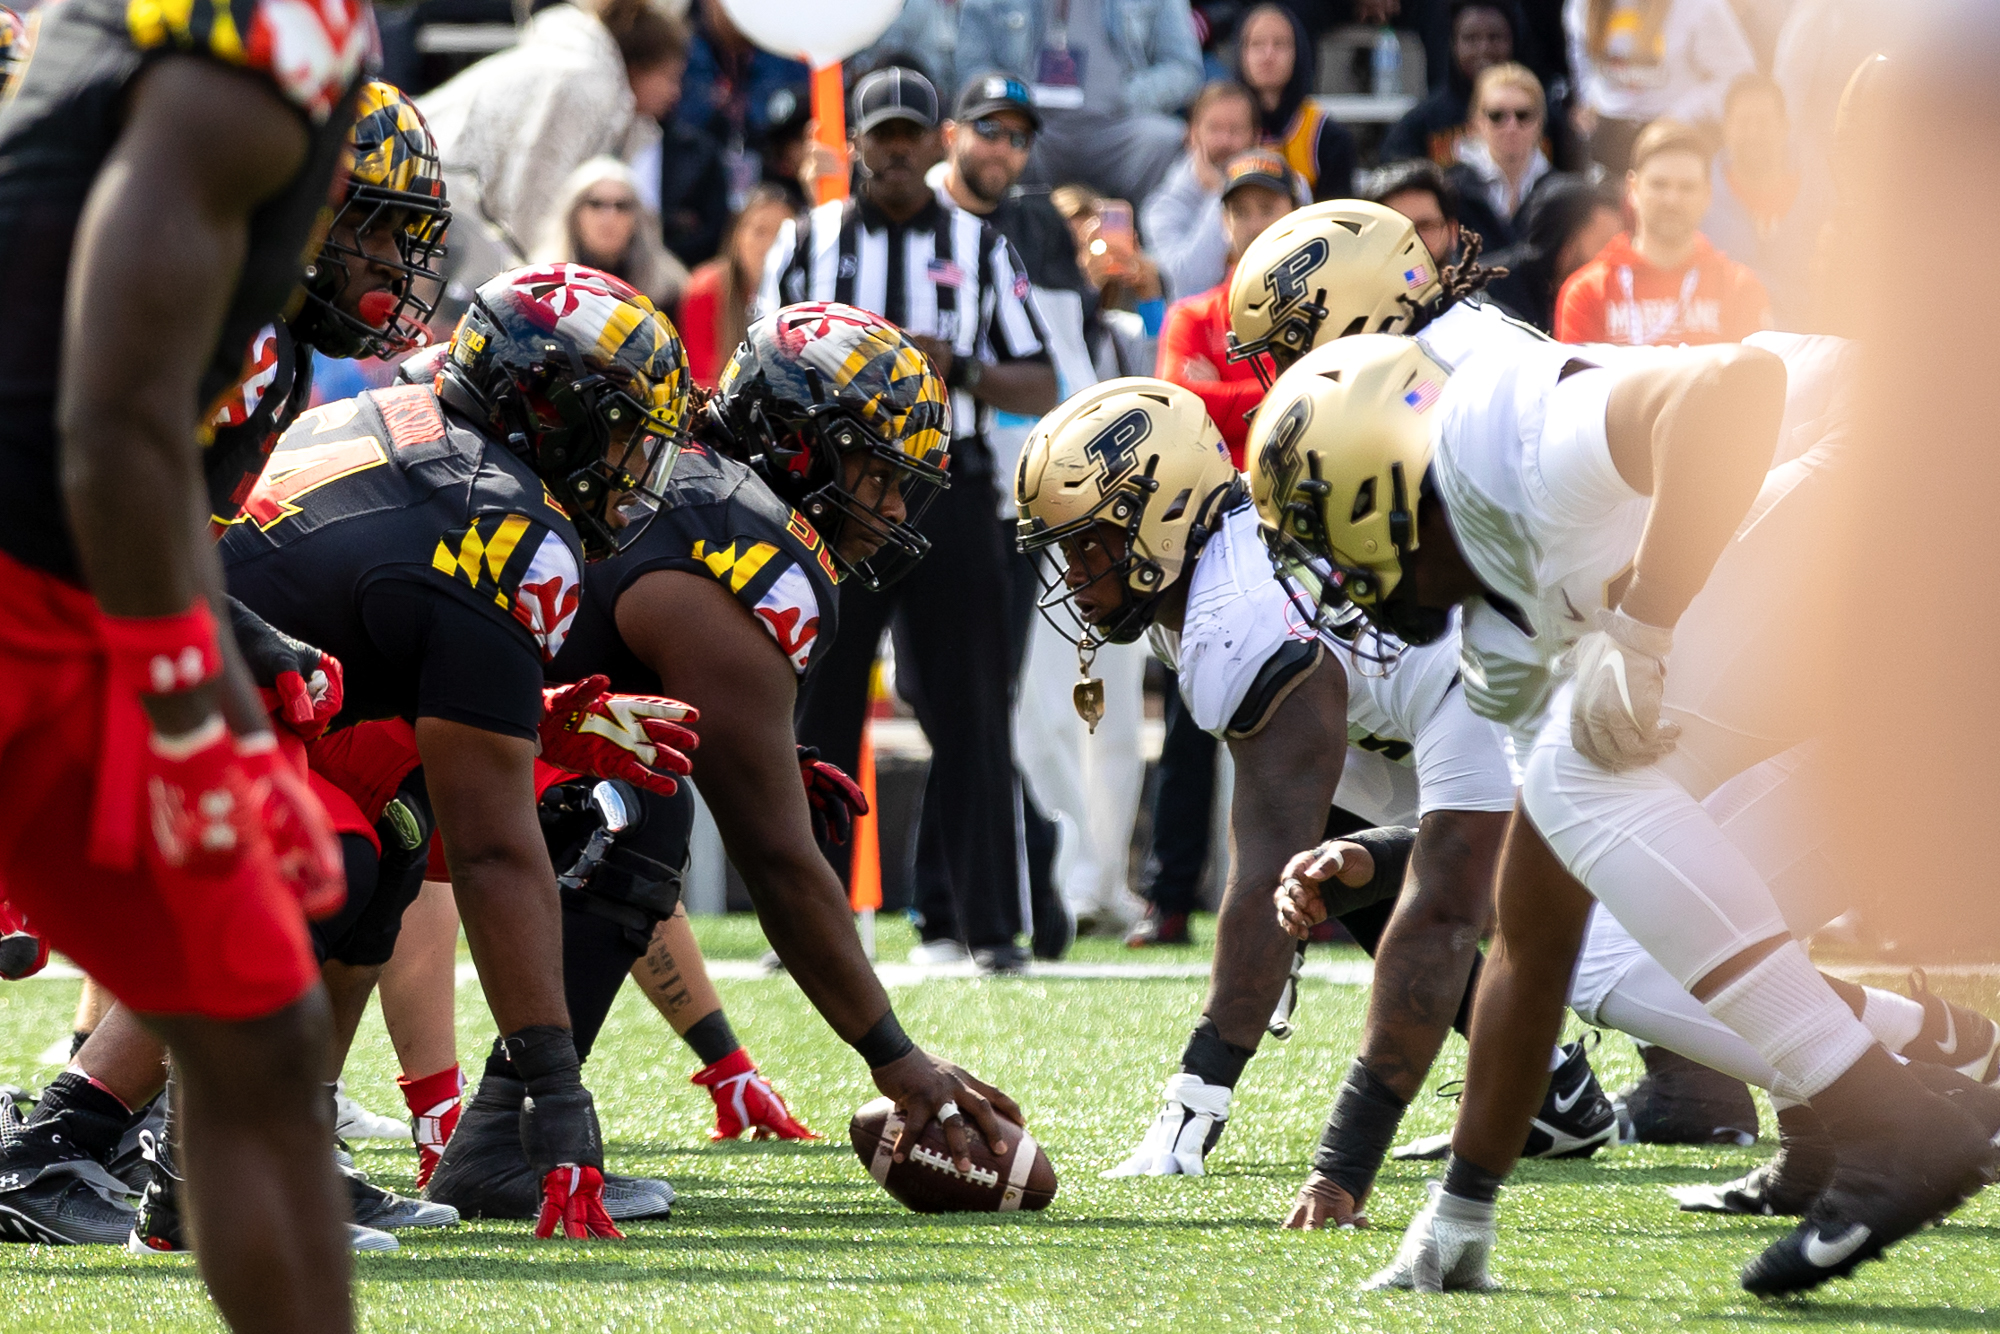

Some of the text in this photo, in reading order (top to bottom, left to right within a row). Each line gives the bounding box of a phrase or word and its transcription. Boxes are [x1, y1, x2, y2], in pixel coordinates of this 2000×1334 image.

[1263, 236, 1330, 324] P
[1083, 407, 1153, 500] P
[1258, 392, 1316, 516] P
